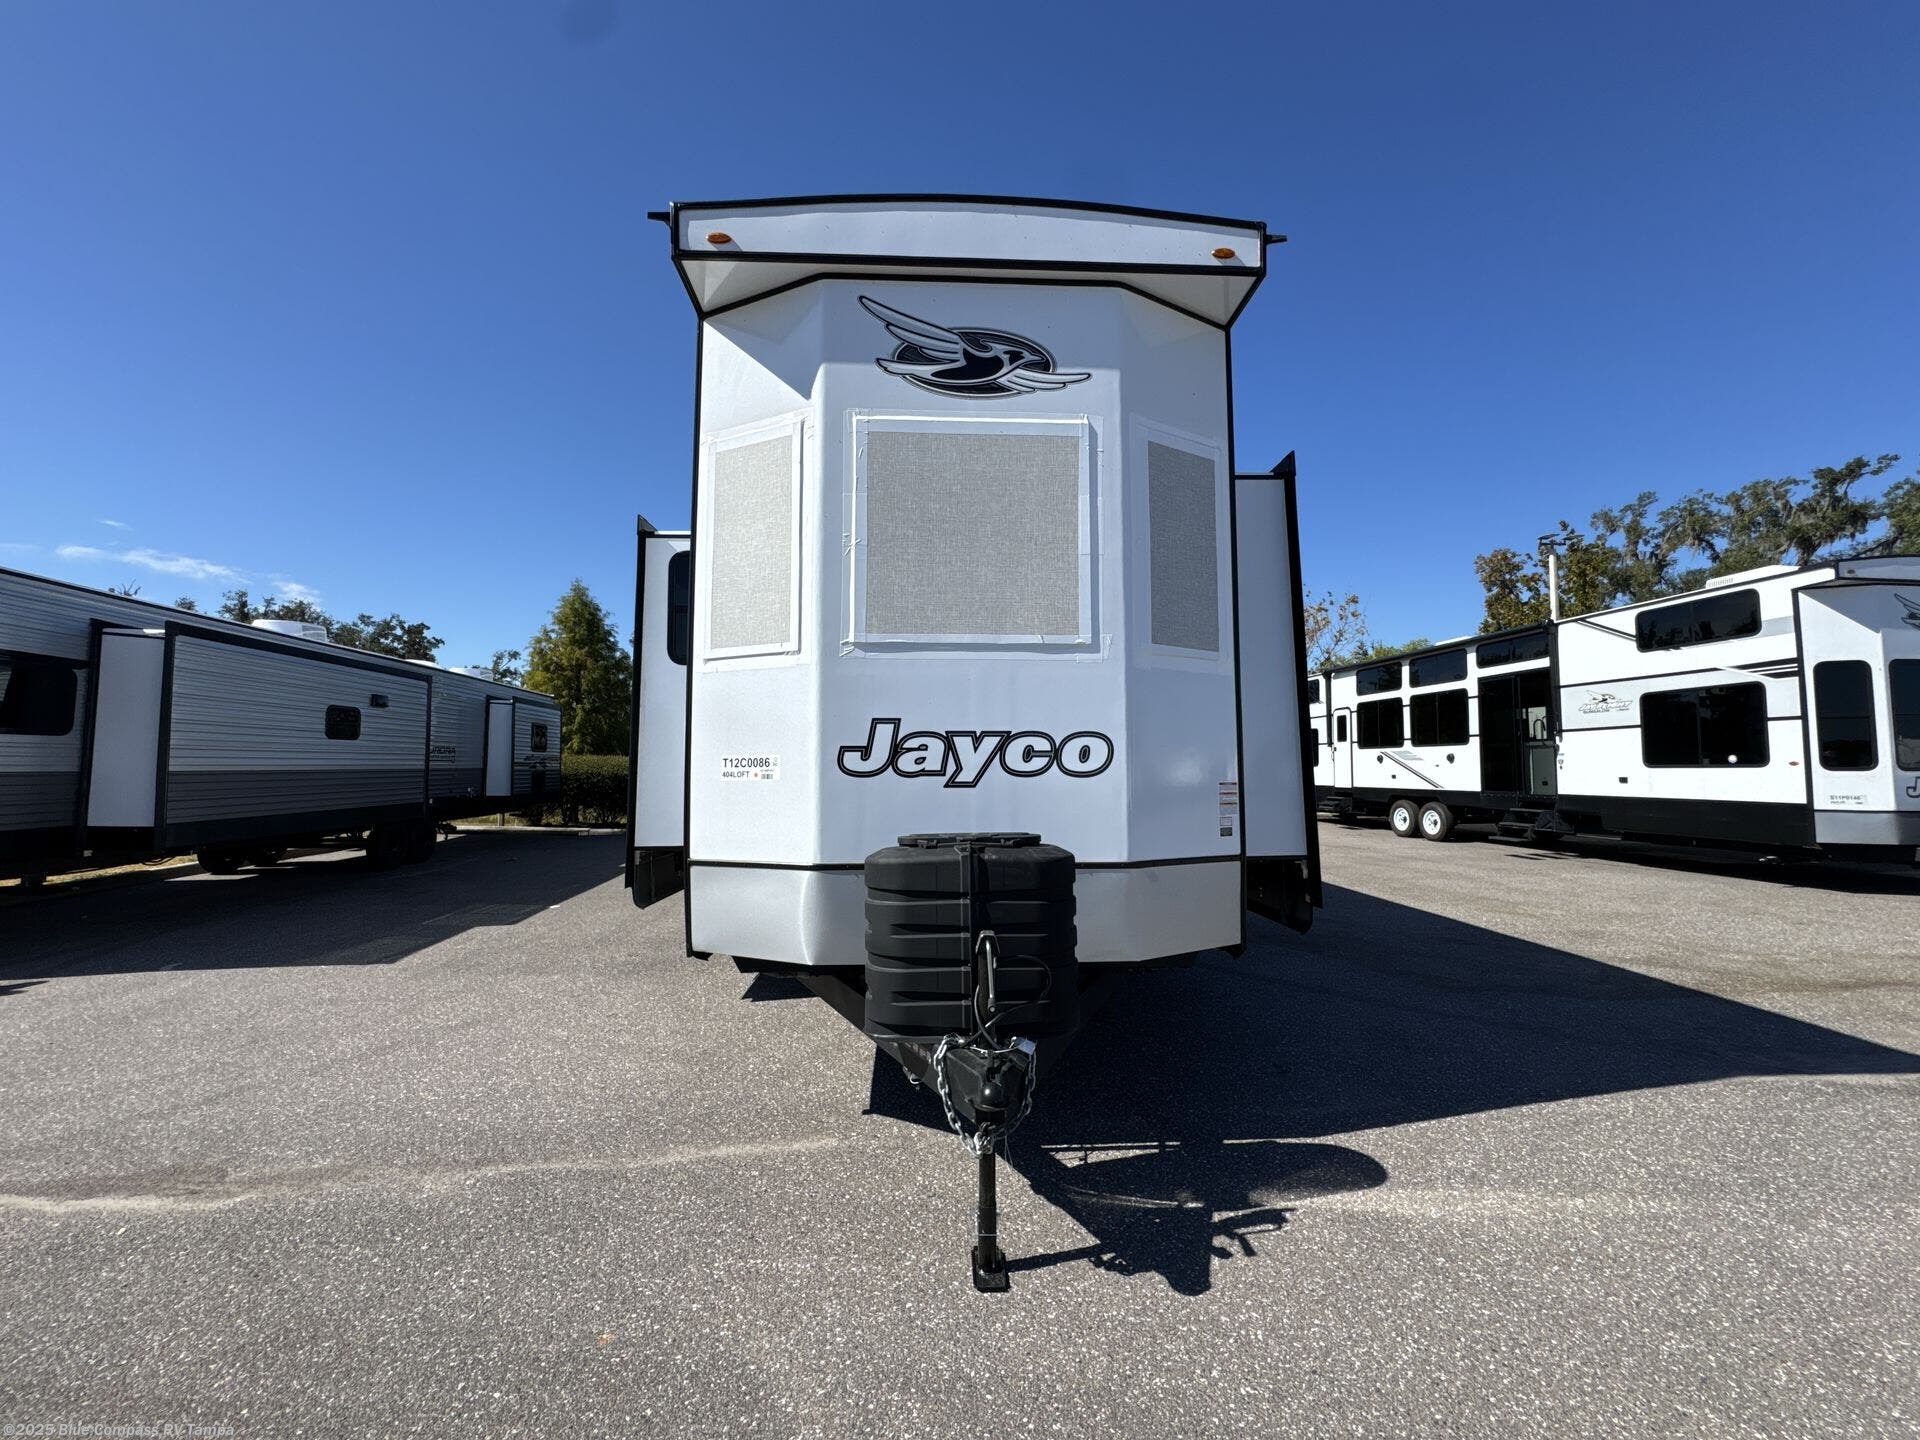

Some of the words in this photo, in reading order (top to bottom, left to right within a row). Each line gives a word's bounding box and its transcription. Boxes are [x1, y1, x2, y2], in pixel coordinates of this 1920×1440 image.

[837, 717, 1114, 788] Jayco
[722, 757, 771, 768] T12C0086
[722, 770, 750, 778] 404LOFT
